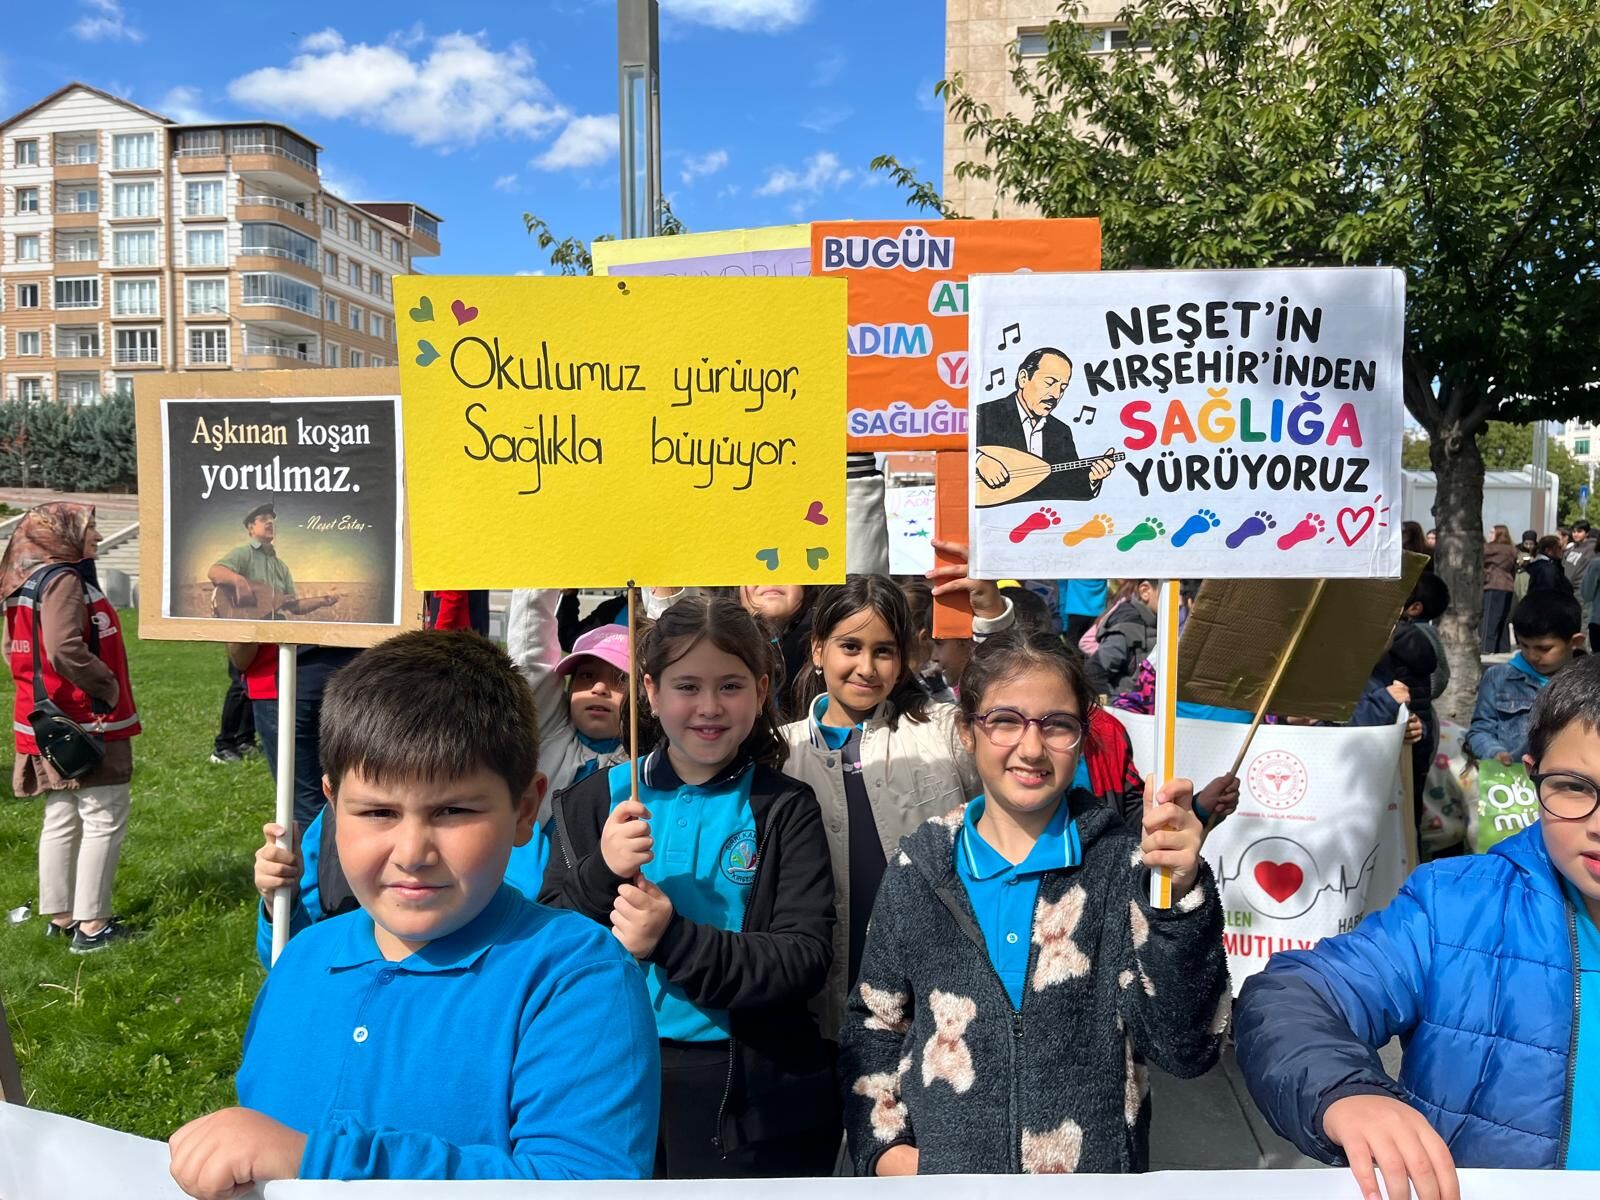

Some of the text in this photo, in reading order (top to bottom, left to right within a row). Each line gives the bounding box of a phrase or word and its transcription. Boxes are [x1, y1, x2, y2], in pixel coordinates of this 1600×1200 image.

[825, 228, 951, 269] BUGÜN
[450, 336, 799, 412] Okulumuz yürüyor,
[941, 357, 968, 385] Y
[191, 416, 371, 453] Aşkınan koşan
[1119, 386, 1363, 451] SAĞLIĞA
[464, 402, 797, 495] Sağlıkla büyüyor.
[200, 455, 361, 500] yorulmaz.
[1125, 447, 1371, 497] YÜRÜYORUZ
[1488, 783, 1538, 809] Ob
[1224, 911, 1253, 928] LEN
